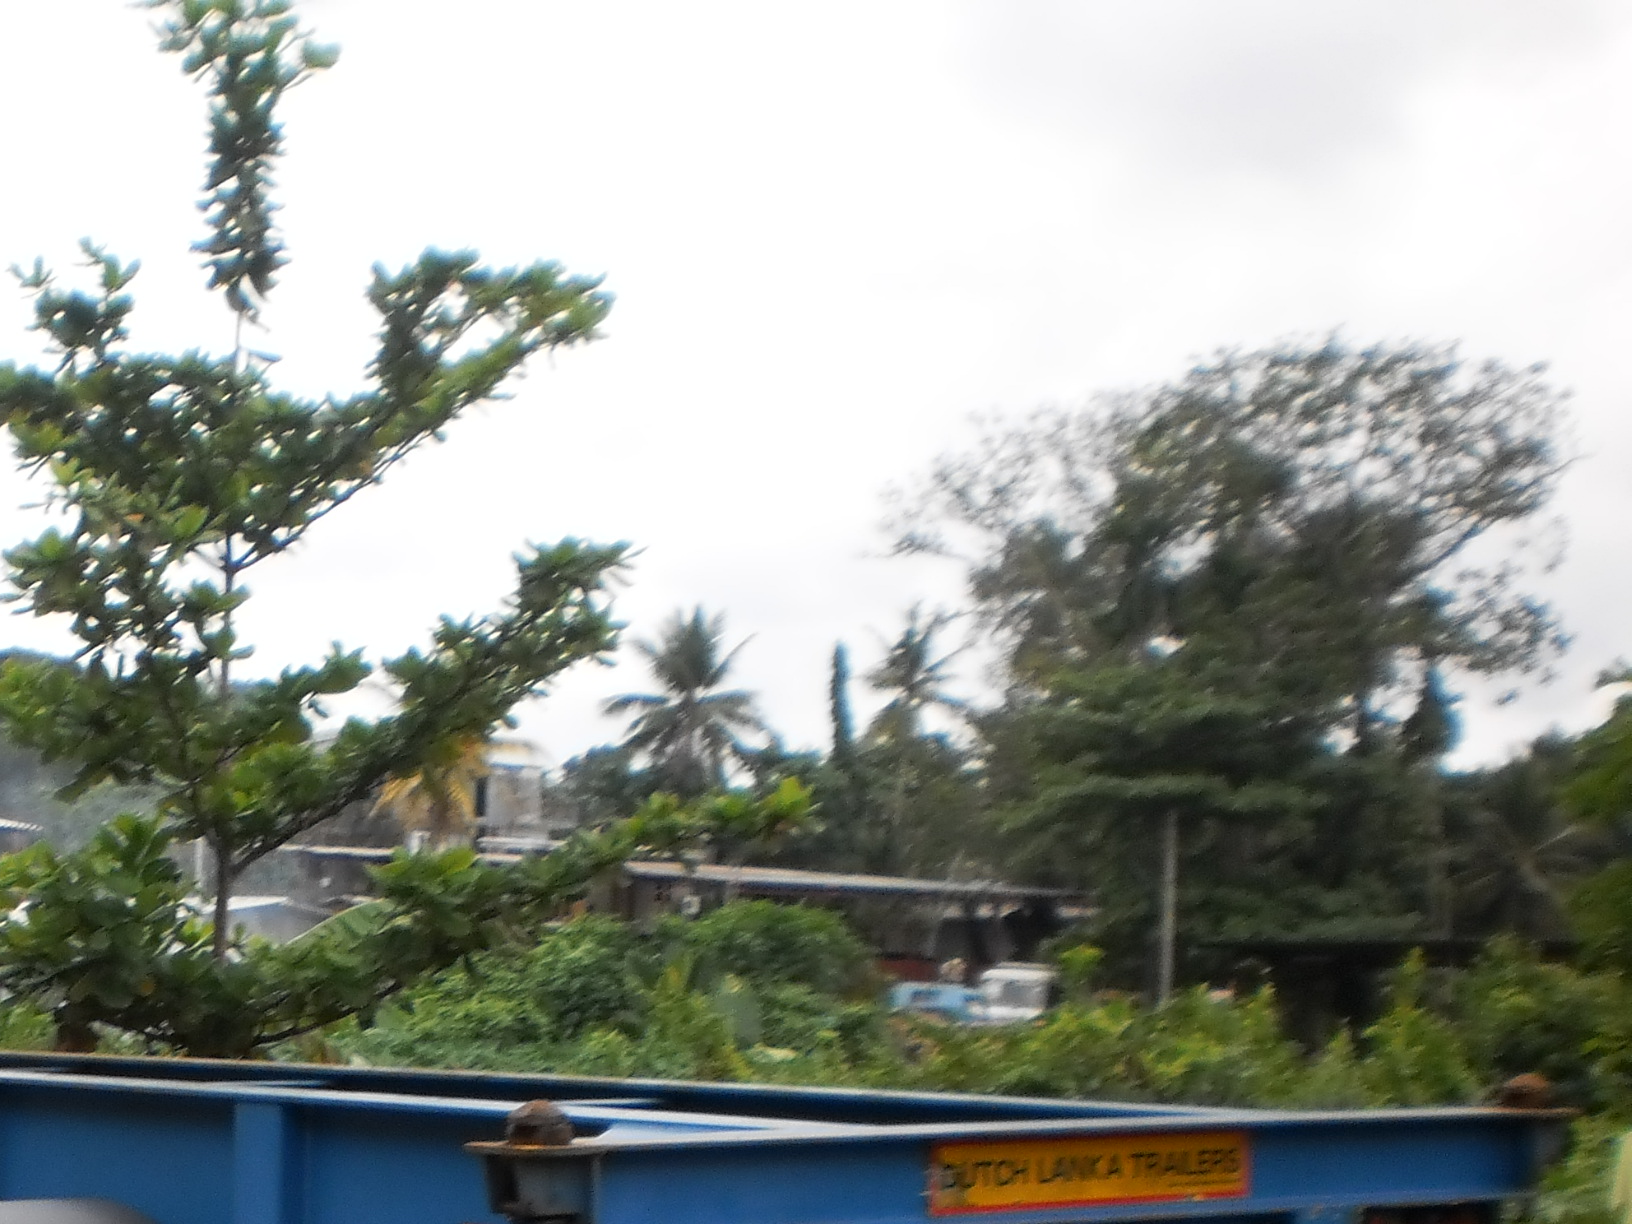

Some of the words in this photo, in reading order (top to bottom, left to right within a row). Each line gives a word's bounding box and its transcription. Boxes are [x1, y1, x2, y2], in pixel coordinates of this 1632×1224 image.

[937, 1159, 1031, 1190] DUTCH
[1036, 1152, 1123, 1184] LANKA
[1129, 1147, 1241, 1180] TRAILERS
